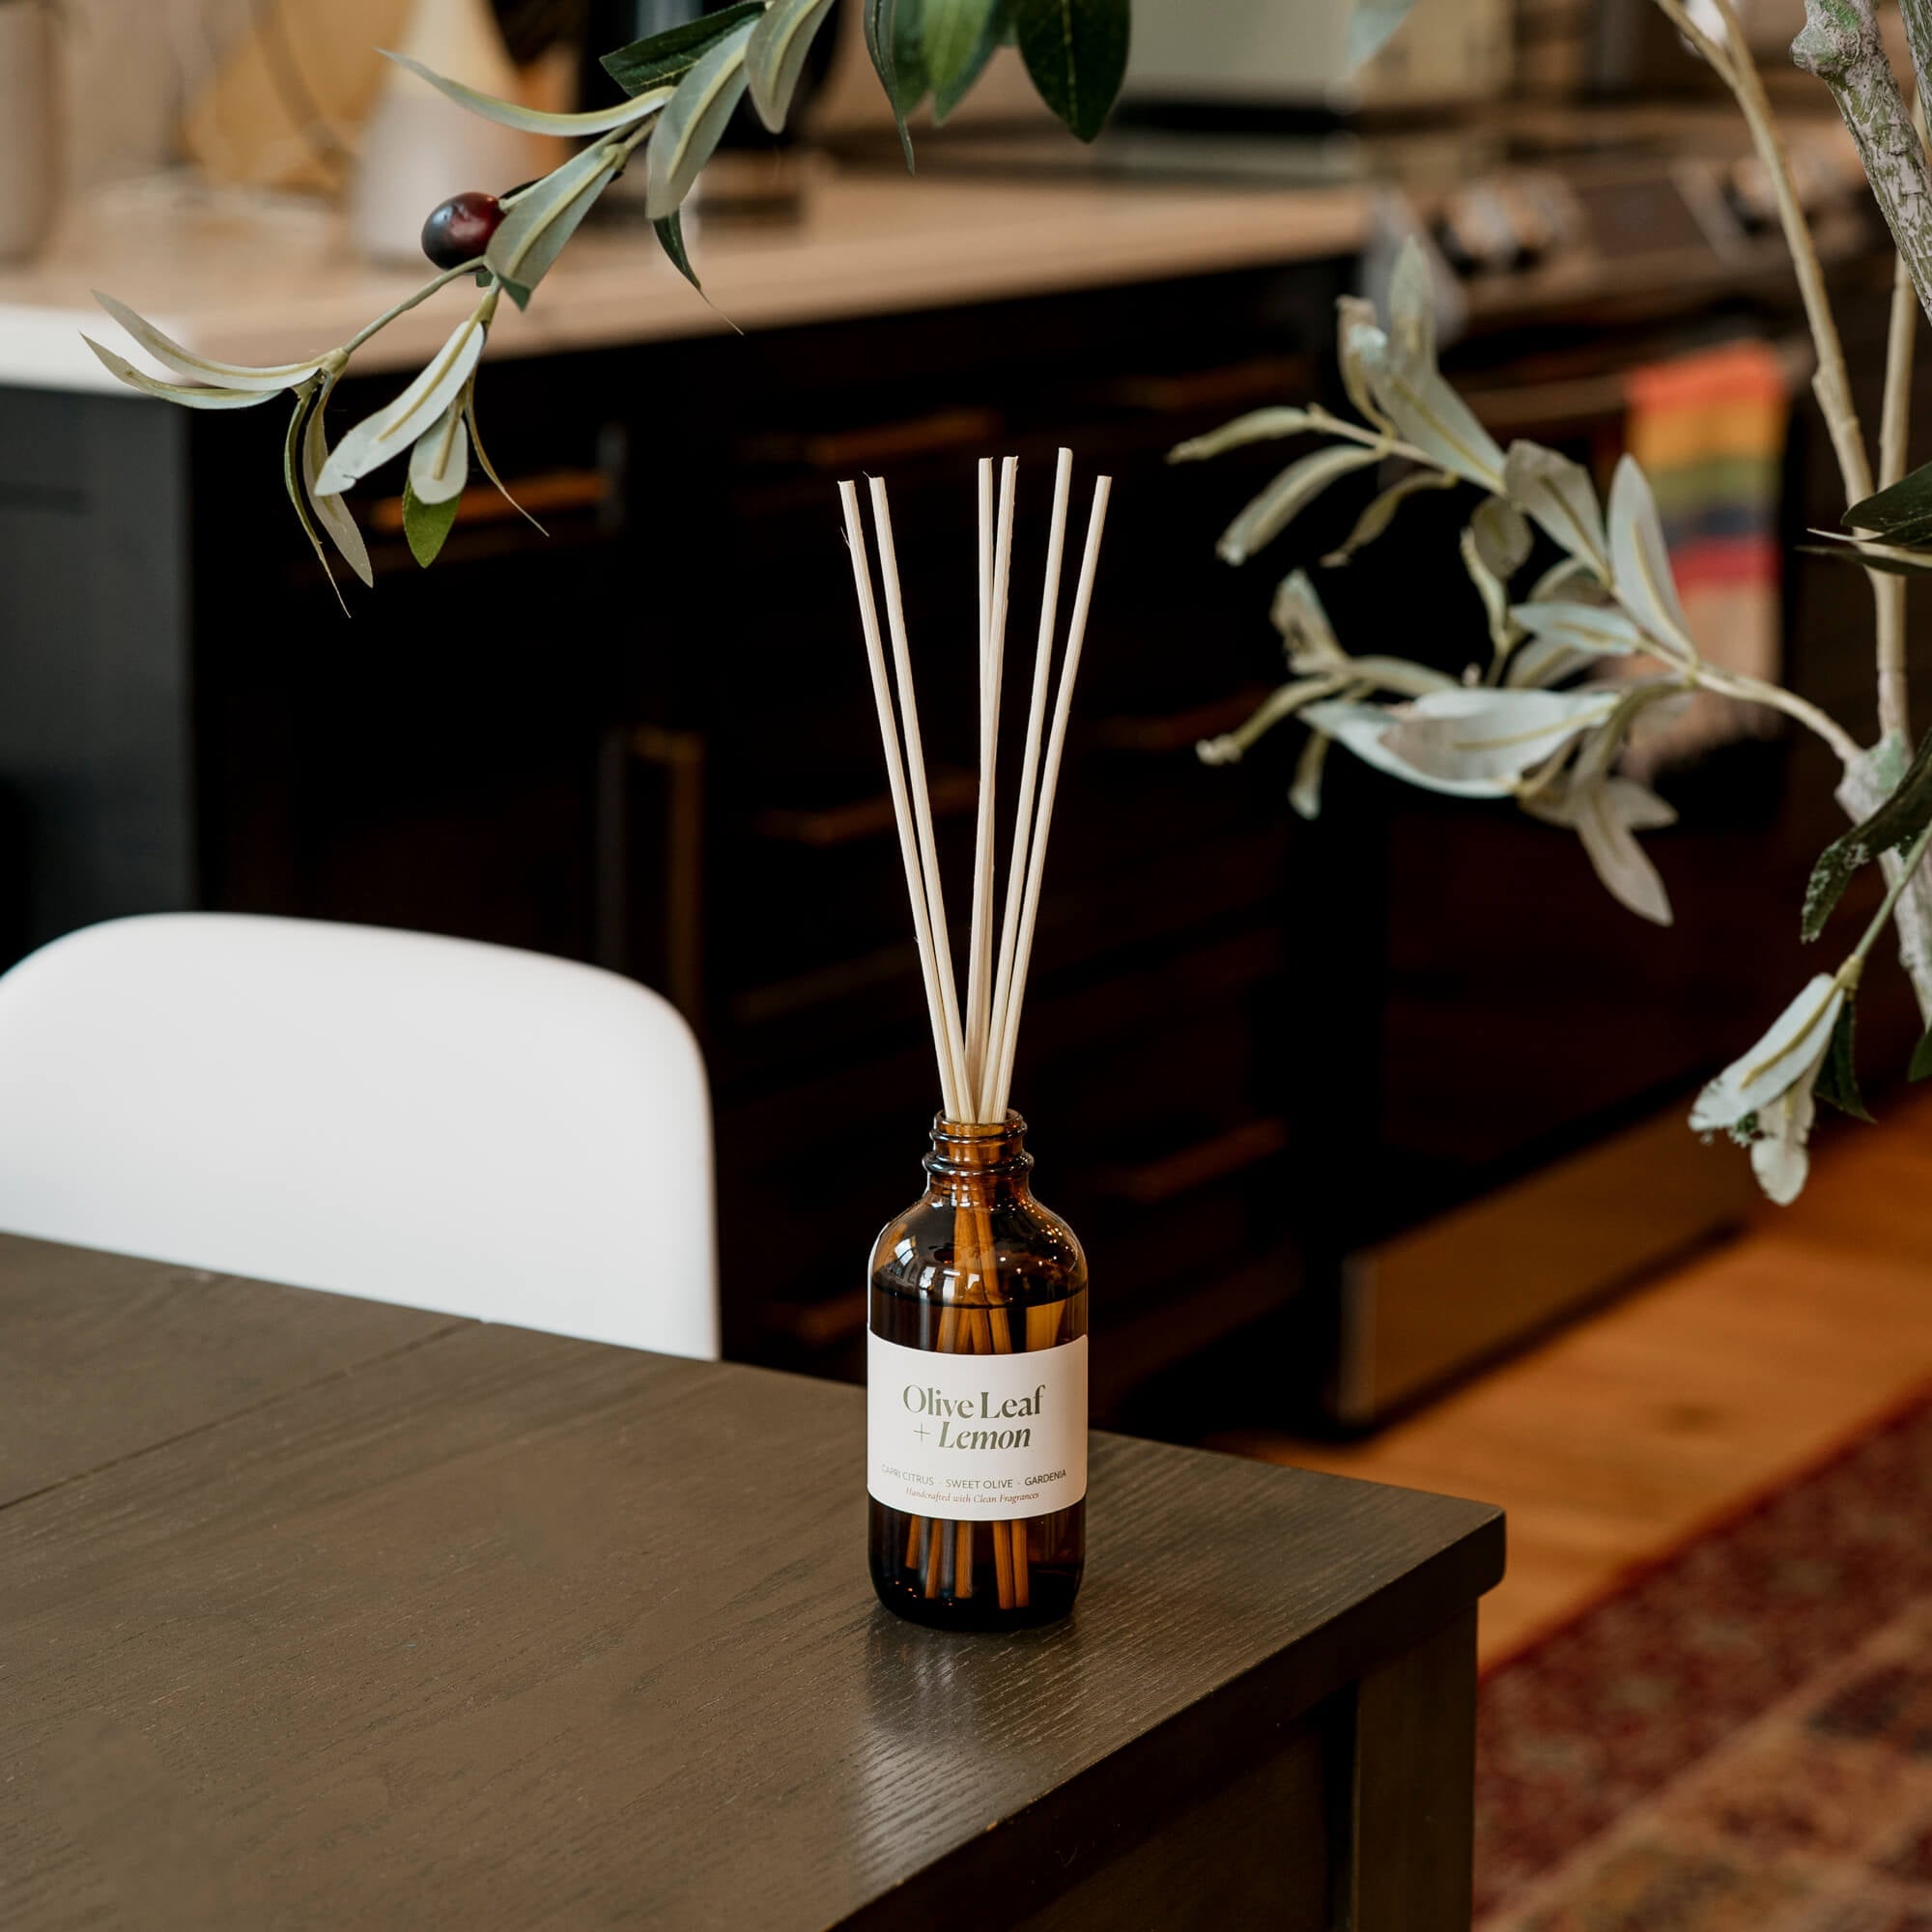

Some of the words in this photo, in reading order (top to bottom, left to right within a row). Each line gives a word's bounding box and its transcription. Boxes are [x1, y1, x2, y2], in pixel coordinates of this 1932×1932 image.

[903, 1384, 974, 1419] Olive
[980, 1384, 1046, 1419] Leaf
[938, 1421, 1031, 1450] Lemon
[902, 1471, 934, 1486] CITRUS
[946, 1479, 981, 1490] SWEET
[982, 1479, 1013, 1489] OLIVE
[1024, 1468, 1066, 1486] GARDENIA
[906, 1487, 951, 1502] Handcrafted
[953, 1492, 971, 1503] with
[973, 1493, 997, 1503] Clean
[999, 1492, 1040, 1504] Fragrances
